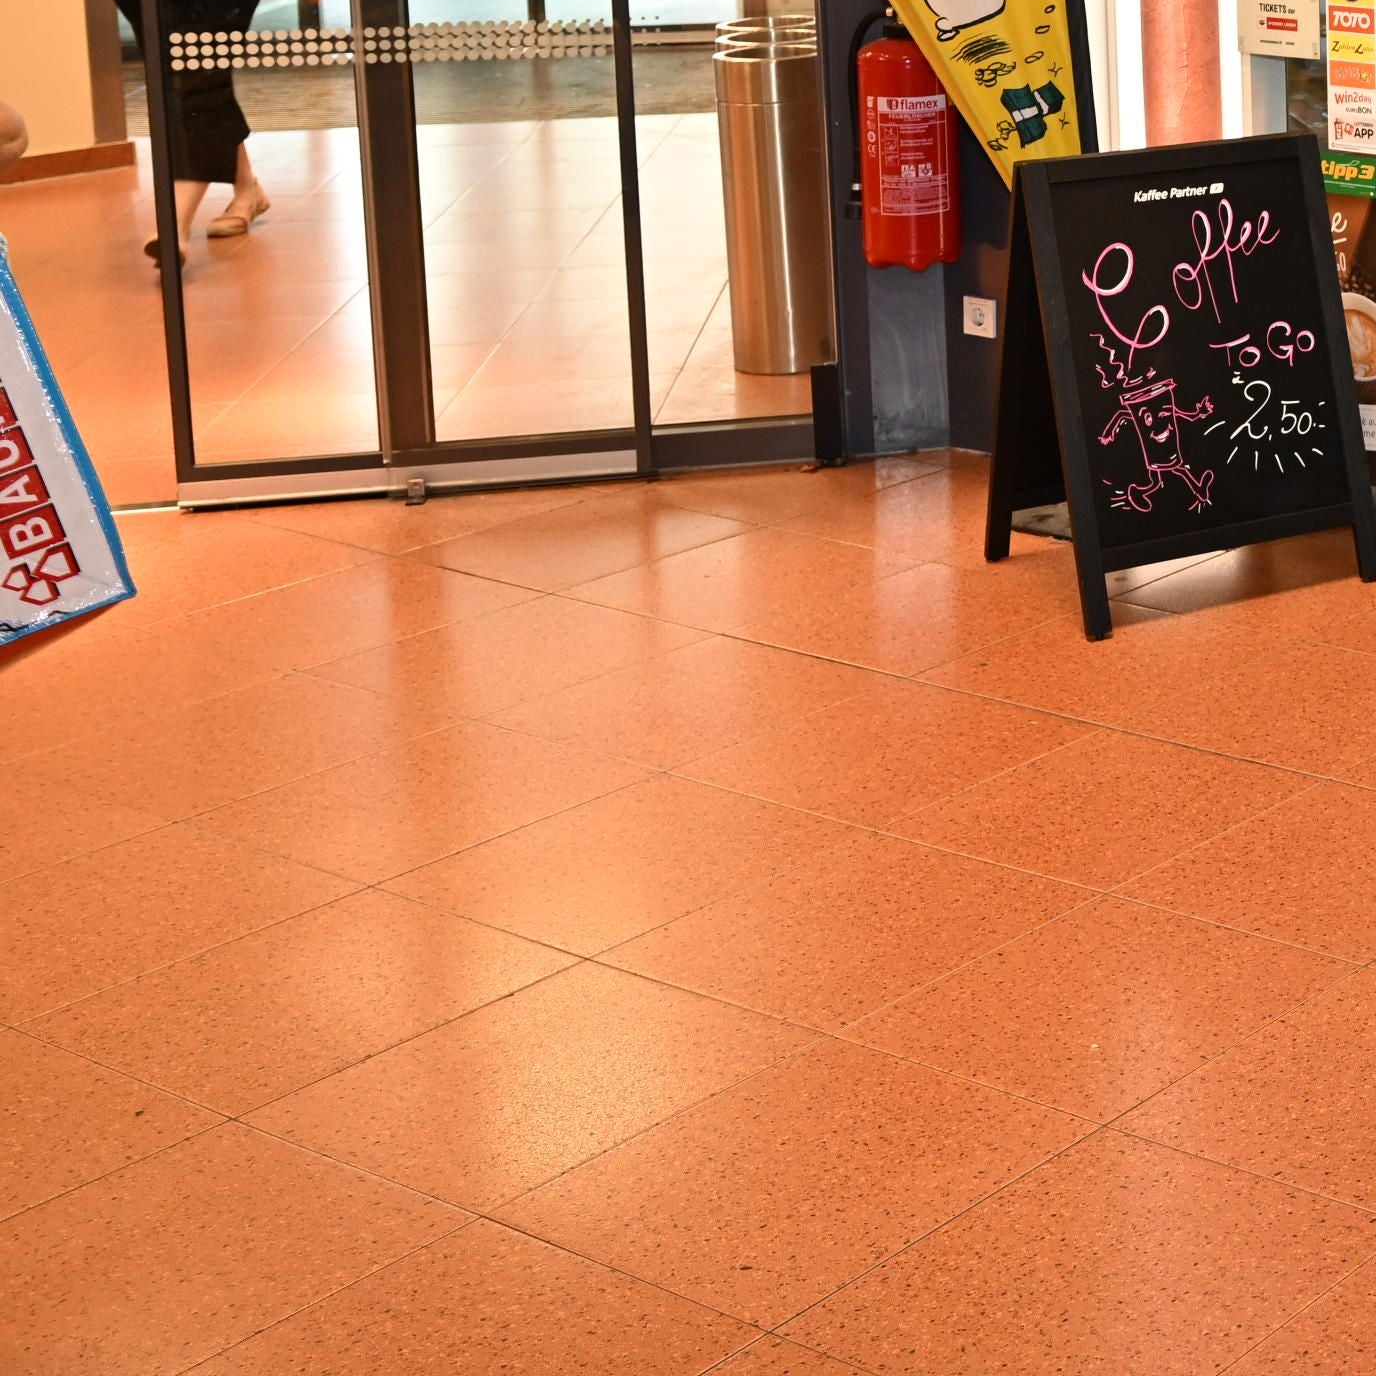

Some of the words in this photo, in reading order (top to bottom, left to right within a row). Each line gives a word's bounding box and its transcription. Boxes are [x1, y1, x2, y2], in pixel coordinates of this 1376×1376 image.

[1259, 2, 1287, 14] TICKETS
[1332, 10, 1371, 30] TOTO
[900, 97, 938, 112] flamex
[1353, 127, 1374, 139] APP
[1133, 188, 1169, 204] Kaffee
[1169, 184, 1208, 200] Partner
[1083, 198, 1281, 373] Coffee
